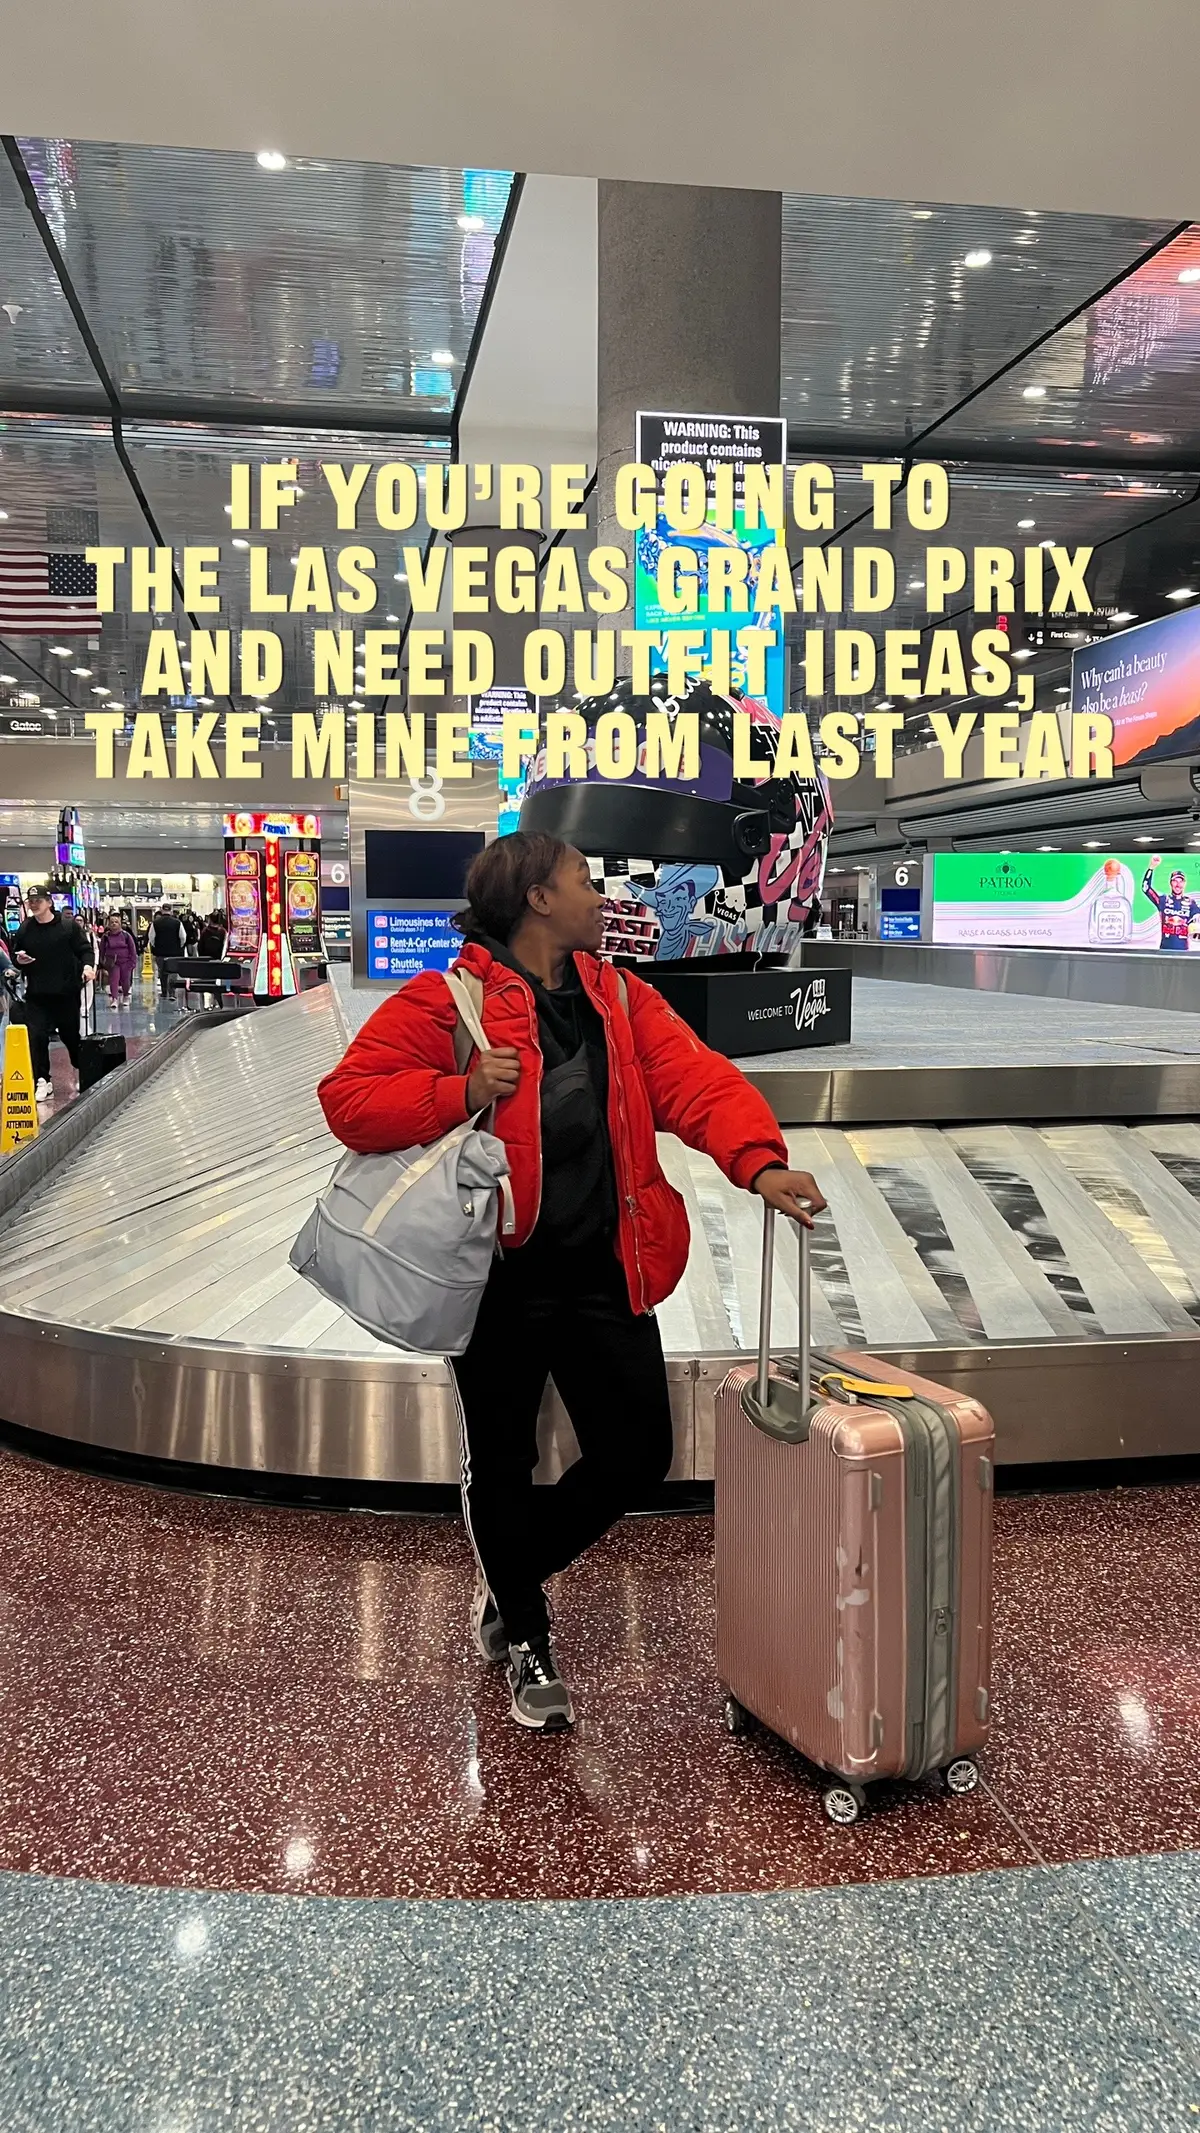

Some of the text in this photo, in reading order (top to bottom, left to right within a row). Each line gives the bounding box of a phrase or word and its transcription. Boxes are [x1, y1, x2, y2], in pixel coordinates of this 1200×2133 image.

[663, 421, 760, 440] WARNING: This
[661, 440, 762, 458] product contains
[1081, 667, 1103, 691] Why
[1126, 663, 1132, 677] a
[1134, 652, 1168, 674] beauty
[1081, 681, 1148, 714] also be a beast?
[408, 766, 446, 821] 8
[331, 863, 346, 884] 6
[895, 866, 909, 887] 6
[979, 873, 1033, 889] PATRÓN
[717, 906, 738, 921] VEGAS
[389, 916, 434, 928] Limousines
[434, 917, 446, 927] for
[958, 929, 978, 937] RAISE
[390, 937, 427, 948] Rent-A-Car
[427, 937, 450, 948] Center
[391, 957, 423, 969] Shuttles
[747, 983, 832, 1031] WELCOME TO Vegas
[6, 1092, 29, 1102] CAUTION
[7, 1105, 32, 1115] CUIDADO
[6, 1120, 34, 1129] ATTENTION
